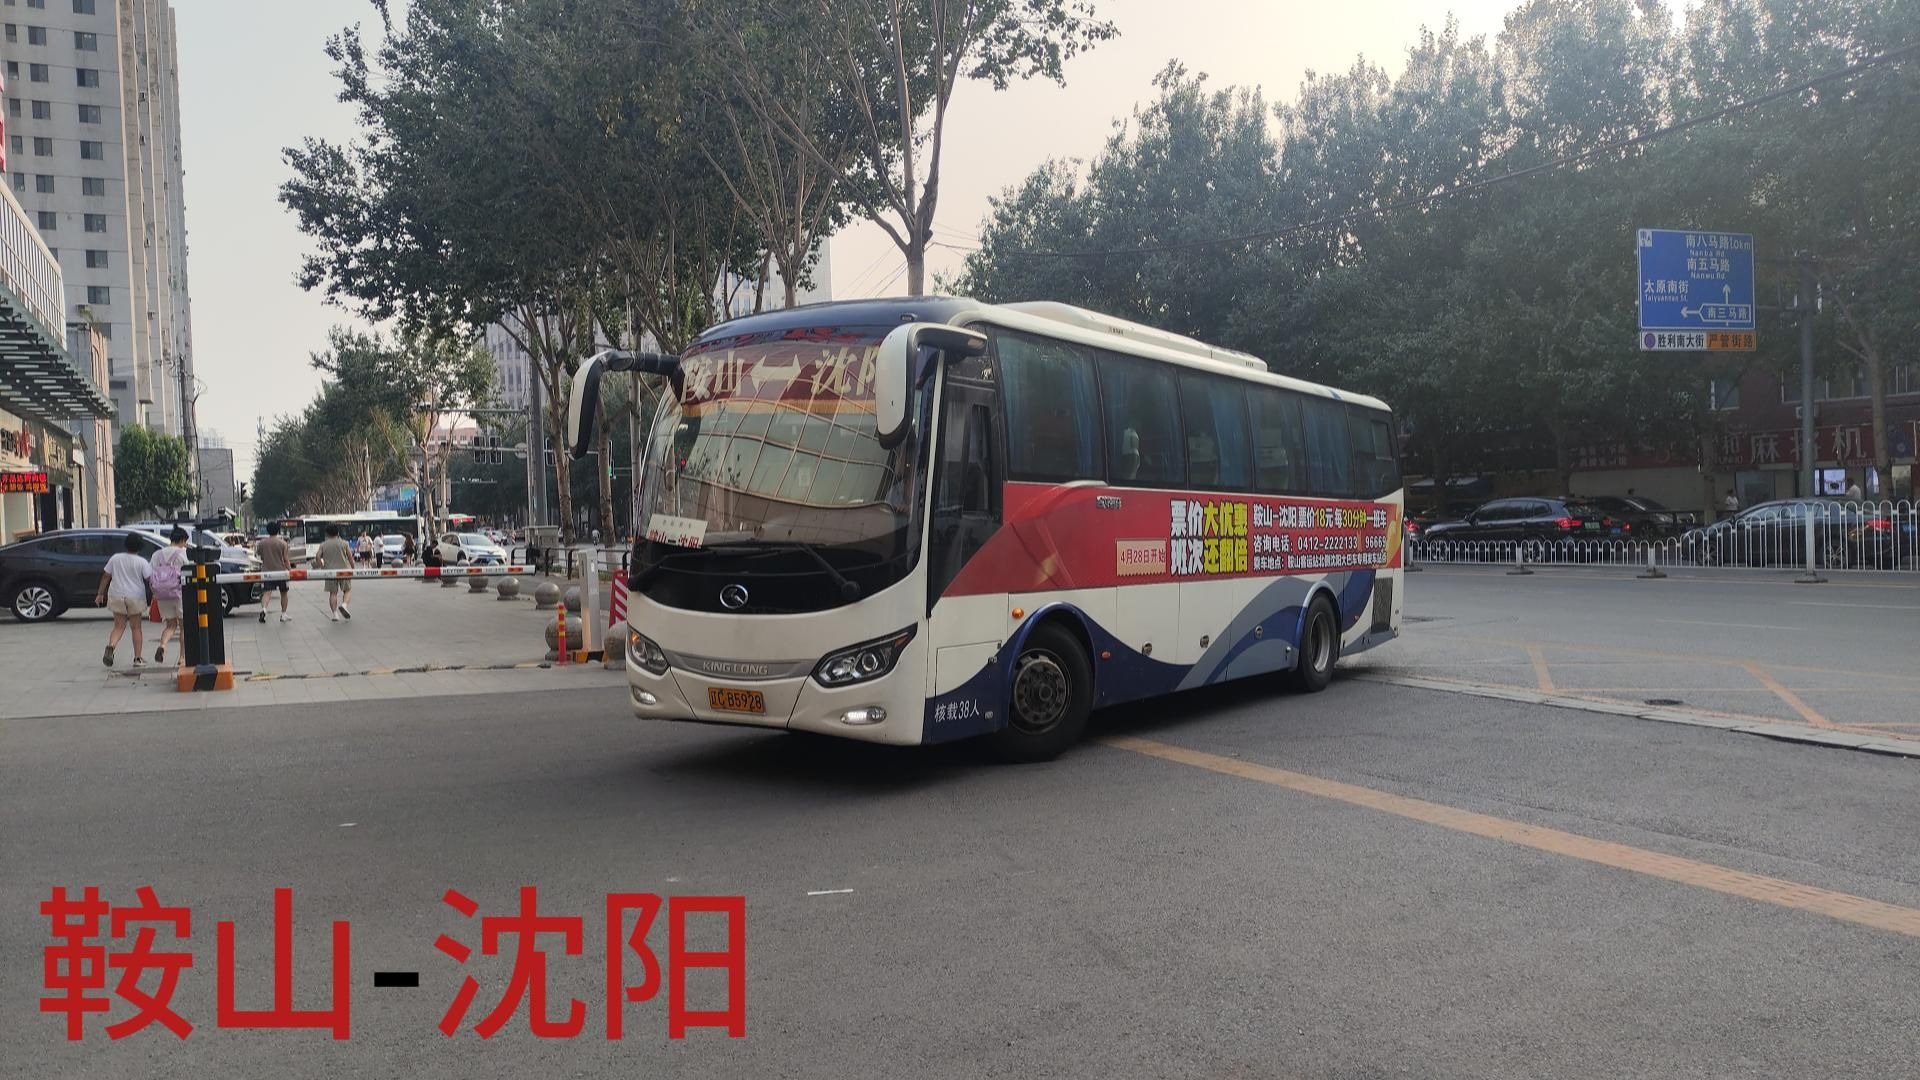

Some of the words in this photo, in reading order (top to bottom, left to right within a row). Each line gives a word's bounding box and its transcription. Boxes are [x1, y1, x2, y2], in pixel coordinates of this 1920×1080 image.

[1687, 258, 1730, 273] 南五马路
[1644, 280, 1689, 294] 太原南街
[1707, 307, 1748, 319] 南三马路
[1657, 333, 1704, 348] 胜利南大街
[681, 349, 744, 403] 鞍山
[1171, 500, 1248, 537] 票价大优惠
[1120, 547, 1165, 565] 4月28日开始
[1171, 537, 1248, 576] 班次还翻倍
[703, 659, 731, 672] KING
[733, 662, 769, 675] LONG
[934, 698, 980, 723] 核载38人
